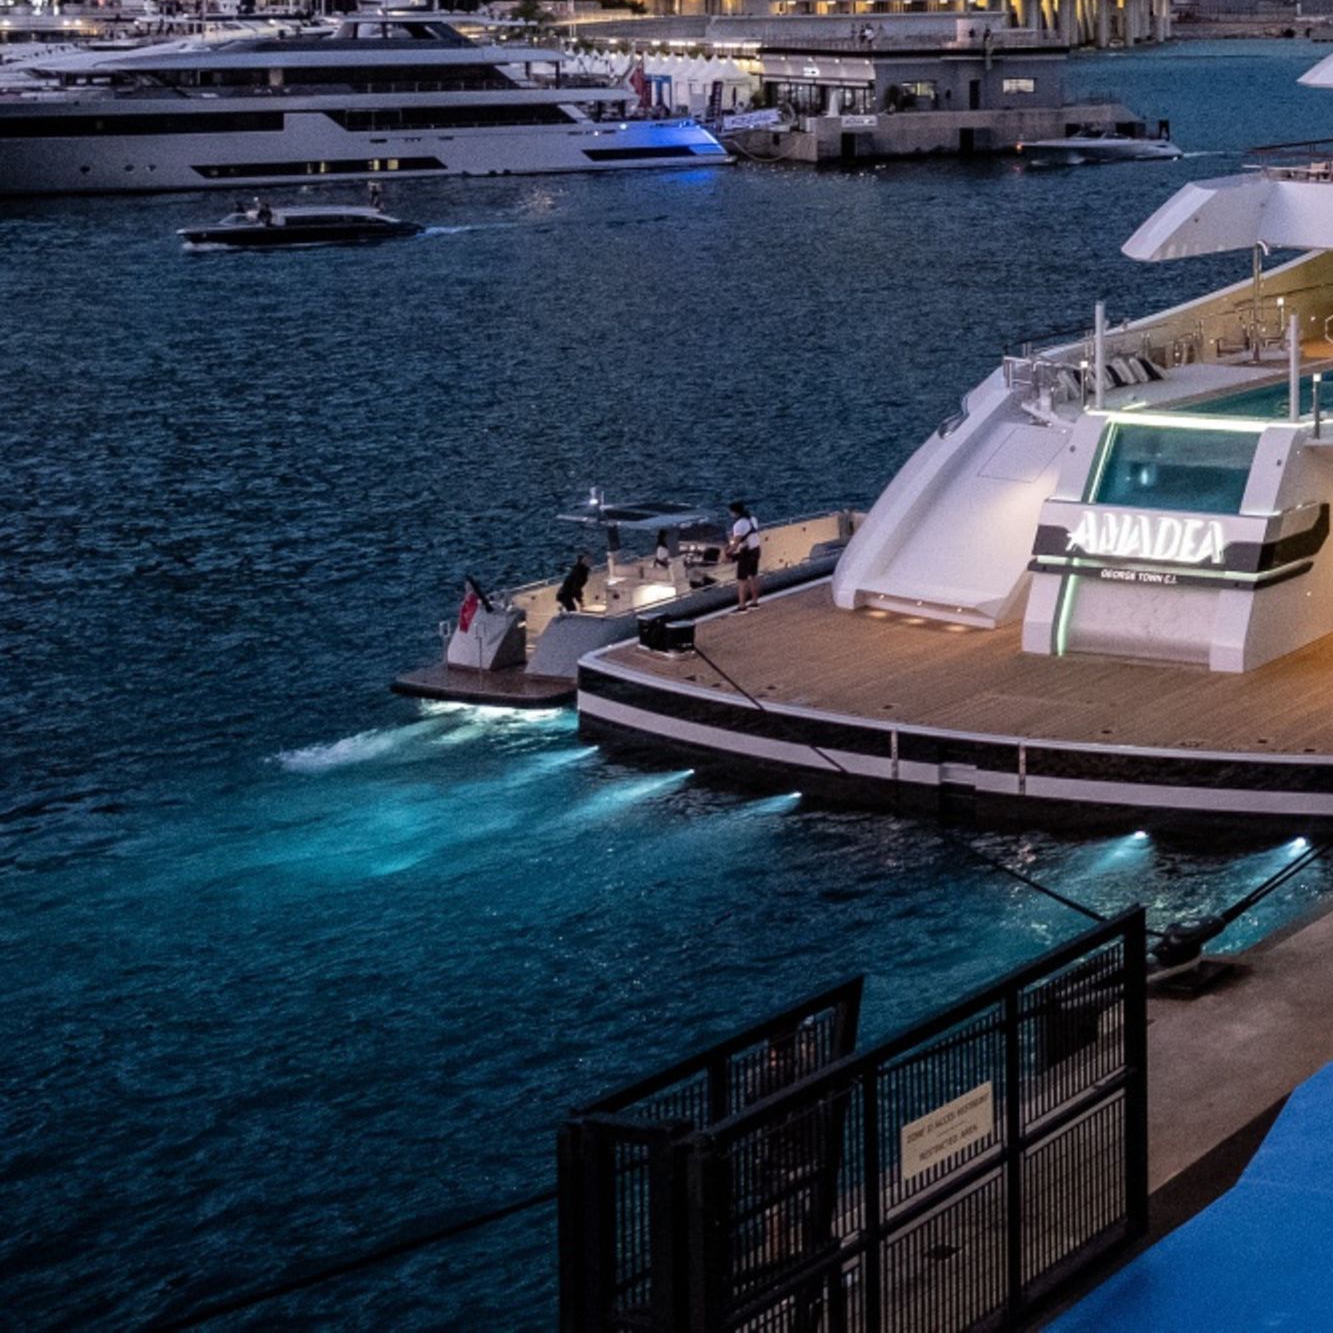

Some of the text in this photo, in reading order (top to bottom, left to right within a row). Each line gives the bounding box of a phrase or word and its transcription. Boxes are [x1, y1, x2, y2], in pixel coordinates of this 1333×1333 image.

[1065, 510, 1225, 564] AMADEA
[1100, 568, 1136, 581] GEORGE
[1138, 572, 1163, 583] TOWN
